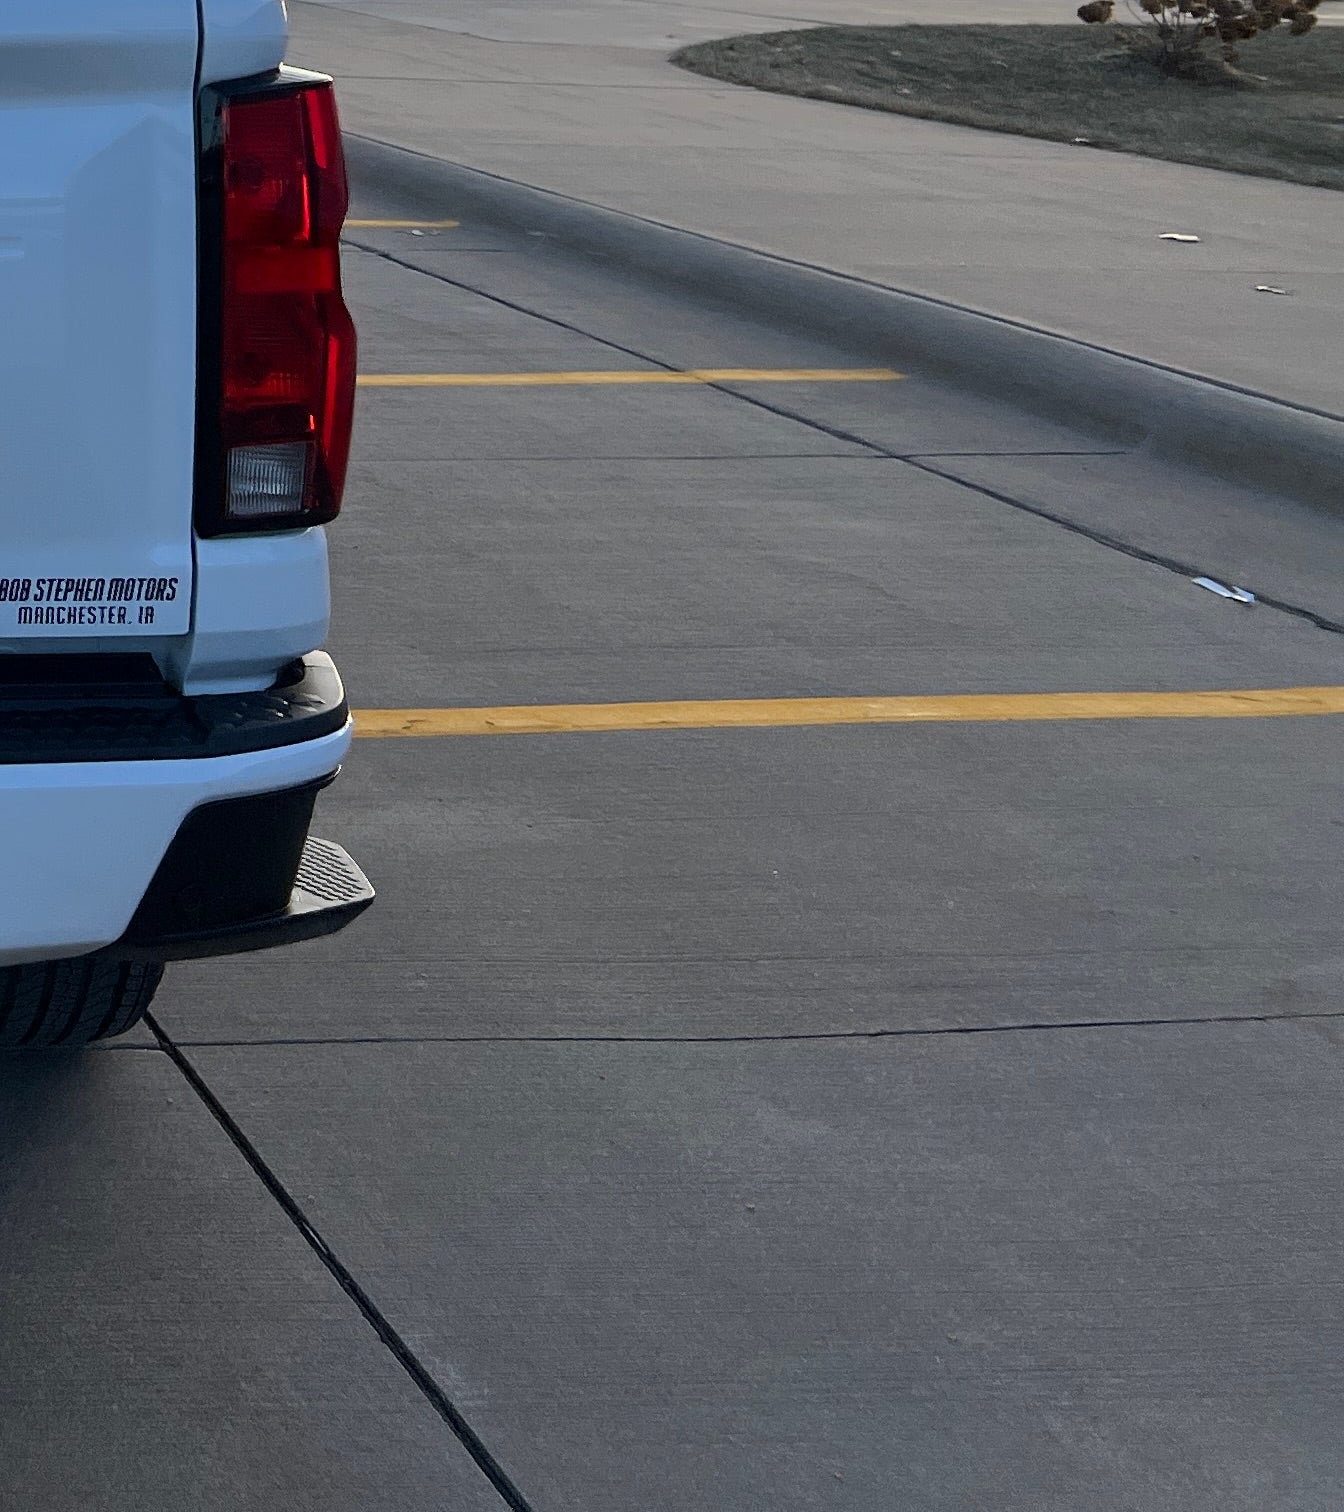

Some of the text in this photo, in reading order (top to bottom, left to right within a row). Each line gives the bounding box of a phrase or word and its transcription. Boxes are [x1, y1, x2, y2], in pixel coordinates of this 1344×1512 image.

[33, 577, 106, 602] STEPHEN
[106, 577, 179, 601] MOTORS
[139, 606, 155, 624] IA
